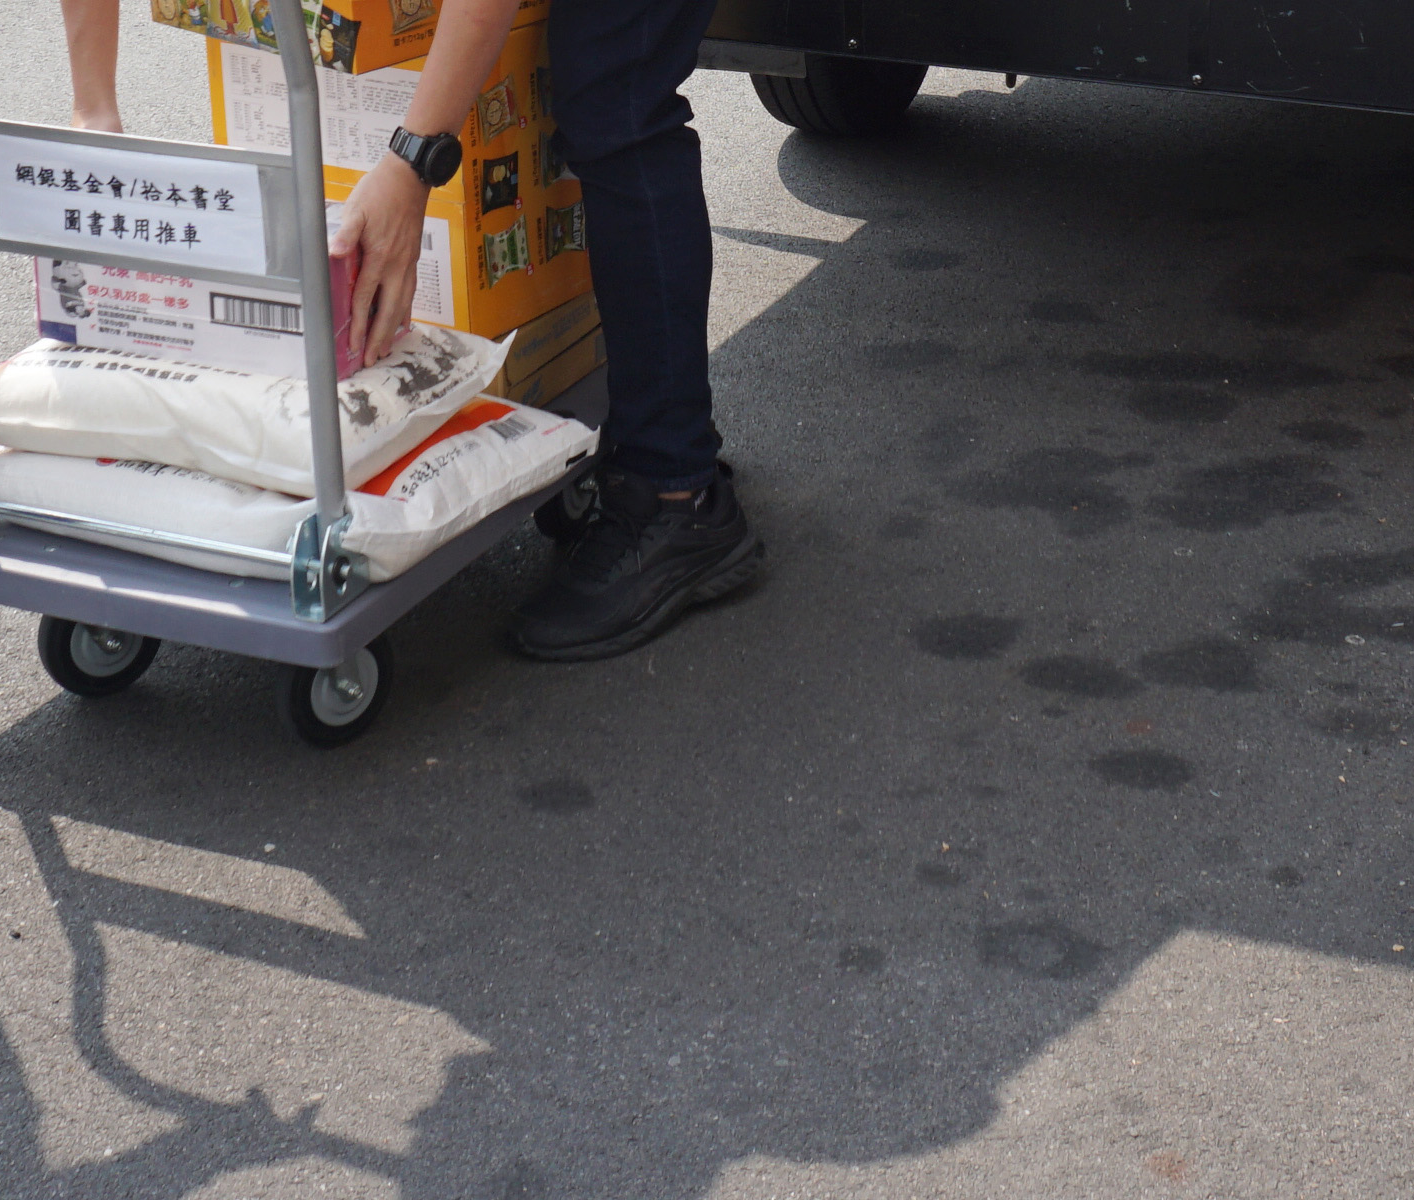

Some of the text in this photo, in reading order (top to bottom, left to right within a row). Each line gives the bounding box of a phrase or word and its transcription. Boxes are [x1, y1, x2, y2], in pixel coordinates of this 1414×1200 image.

[15, 163, 235, 212] 網銀基金會/拾本書堂
[64, 208, 201, 249] 圖書專用推車
